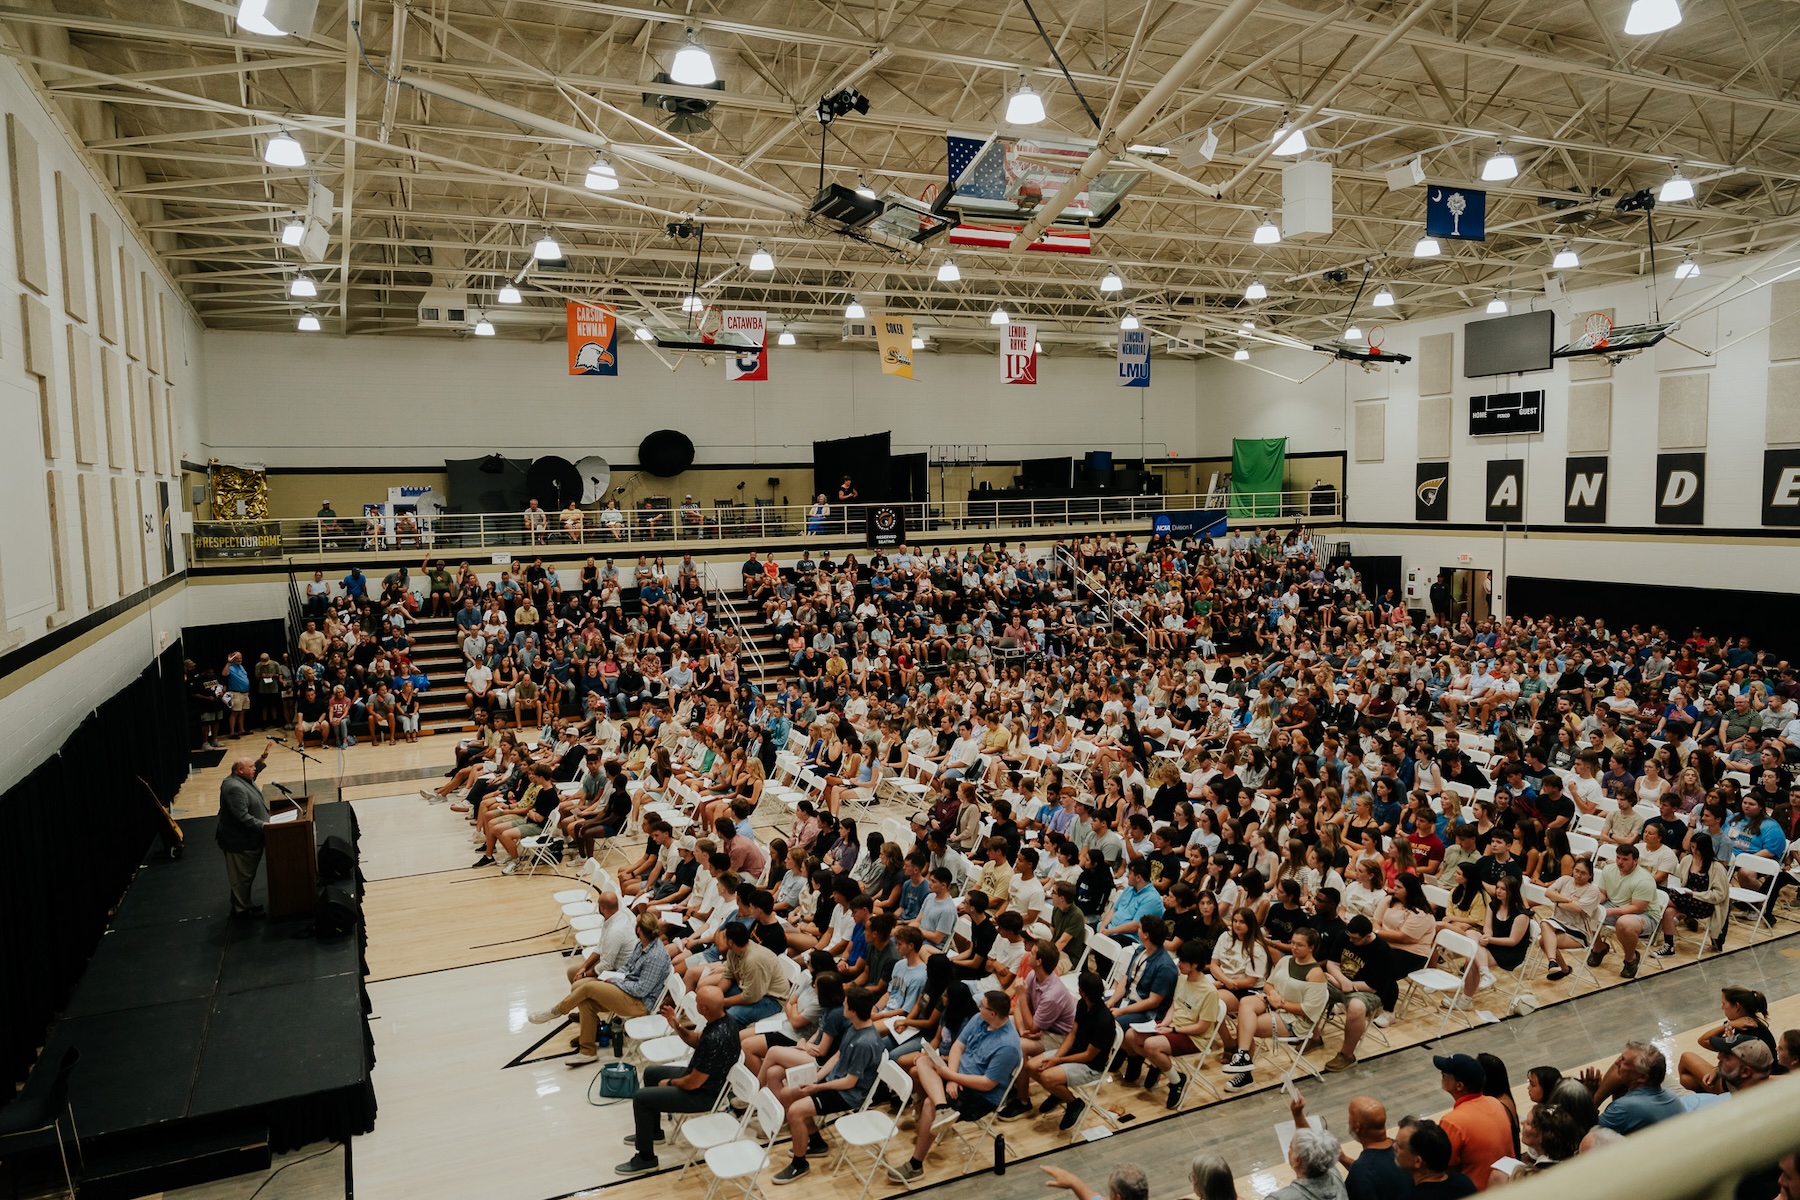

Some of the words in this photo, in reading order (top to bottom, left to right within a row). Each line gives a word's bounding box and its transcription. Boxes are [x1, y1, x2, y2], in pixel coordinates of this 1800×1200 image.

[576, 307, 606, 322] CARSON-
[577, 322, 607, 337] NEWMAN
[728, 317, 763, 330] CATAWBA
[1120, 364, 1148, 379] LMU
[1518, 407, 1537, 416] GUEST
[195, 534, 282, 549] #RESPECTOURGAME
